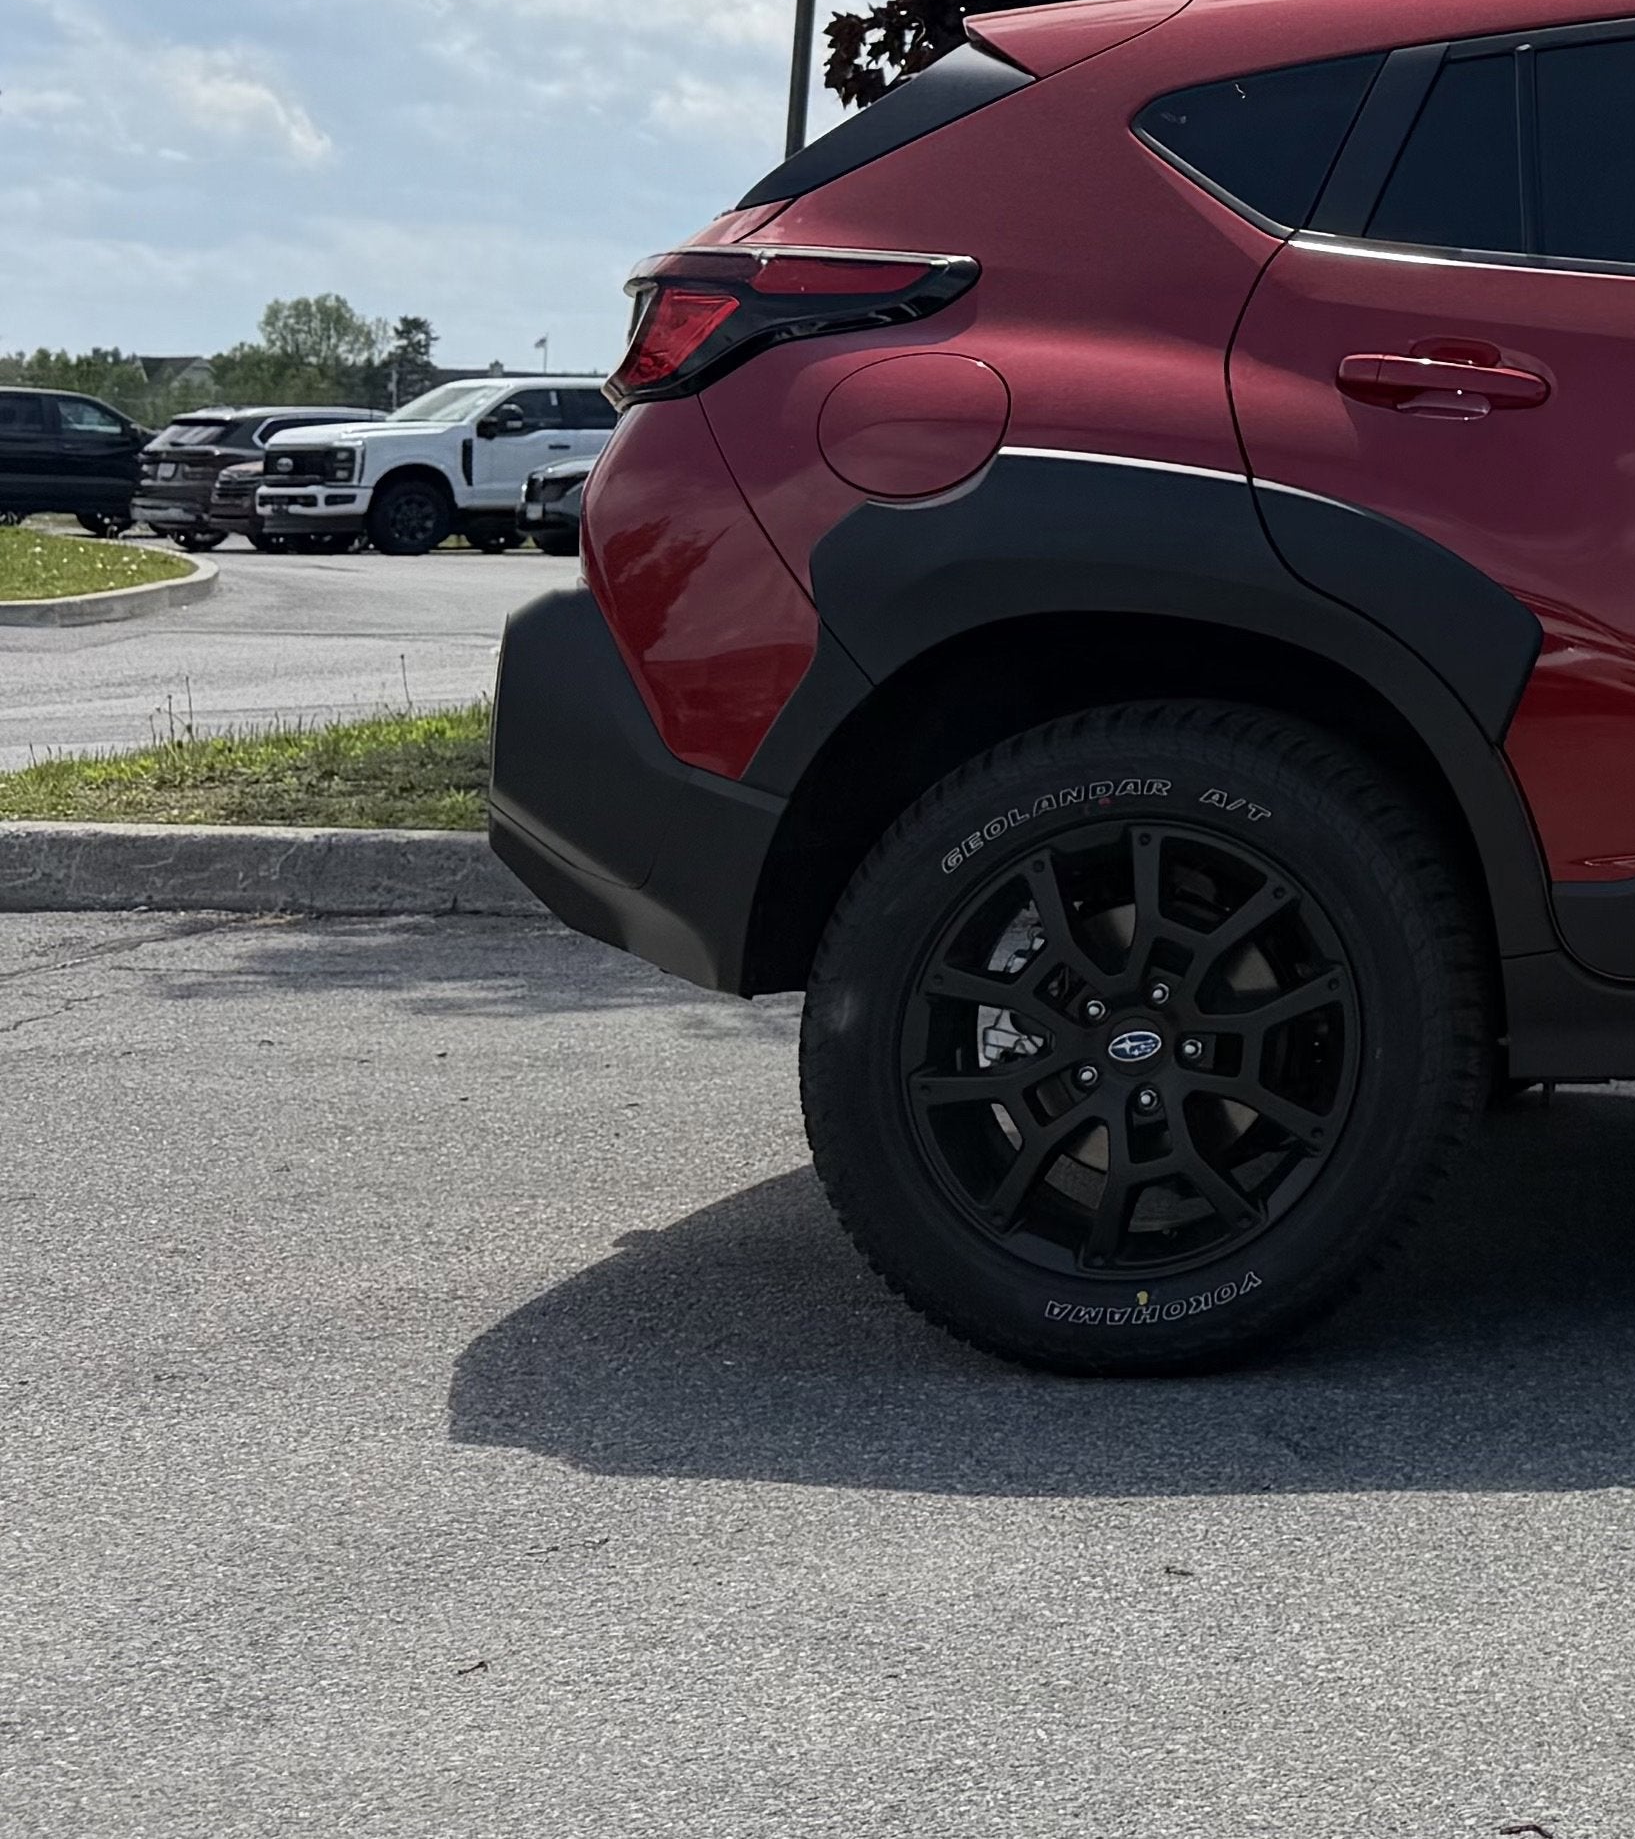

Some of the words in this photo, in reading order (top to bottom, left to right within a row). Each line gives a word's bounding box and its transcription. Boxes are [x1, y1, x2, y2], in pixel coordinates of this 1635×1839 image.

[940, 777, 1172, 874] GEOLANDAR
[1199, 786, 1272, 823] A/T
[1045, 1269, 1262, 1326] YOKOHAMA
